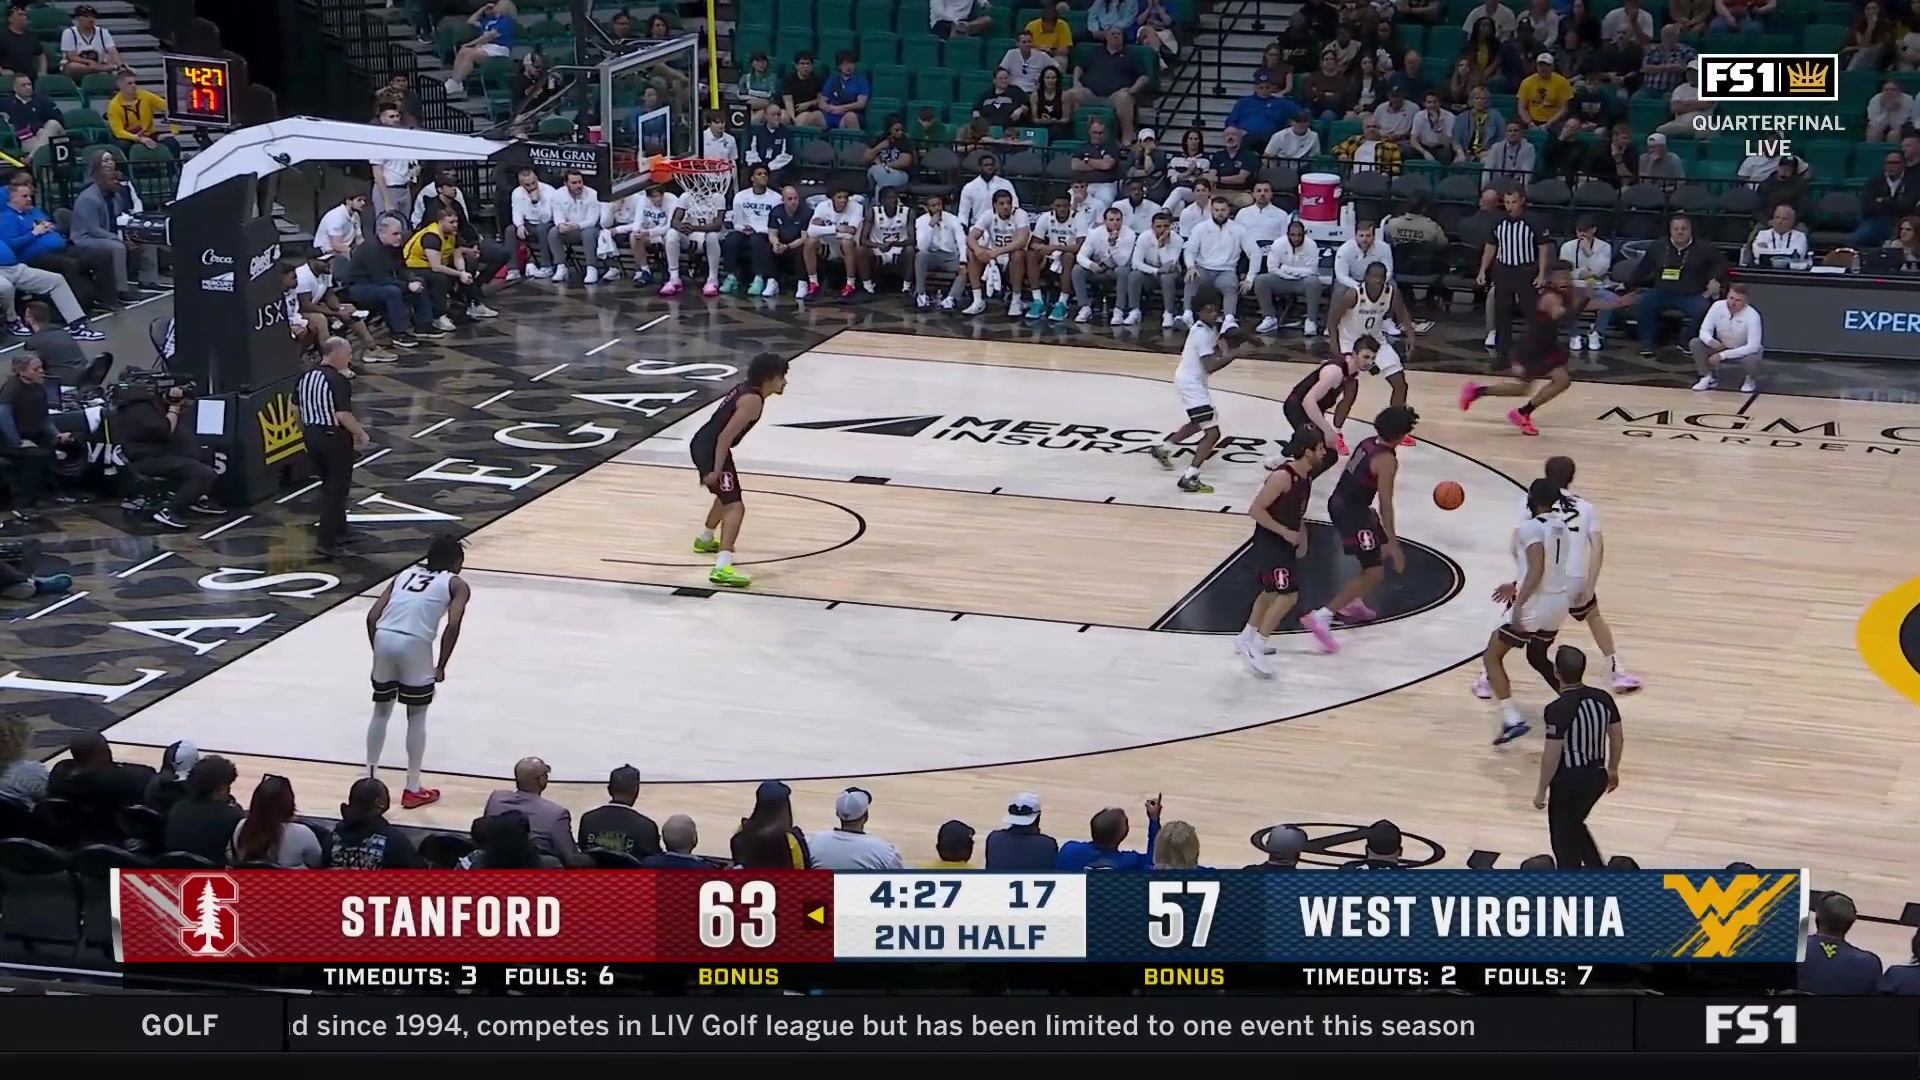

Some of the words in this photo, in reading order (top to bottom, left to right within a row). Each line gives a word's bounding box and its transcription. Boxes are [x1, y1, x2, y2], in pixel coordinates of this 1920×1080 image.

[184, 66, 223, 87] 4:27
[192, 88, 215, 110] 17
[731, 111, 745, 126] C
[55, 145, 69, 161] D
[529, 147, 559, 159] MGM
[533, 159, 567, 167] GARDEN
[882, 232, 900, 242] 23
[254, 299, 285, 330] JSX
[1364, 316, 1376, 329] 0
[1844, 310, 1920, 333] EXPER
[1597, 406, 1840, 437] MGM
[313, 359, 738, 526] VEGAS
[1622, 429, 1902, 455] GARDEN
[401, 573, 435, 592] 13
[0, 566, 341, 704] LAS
